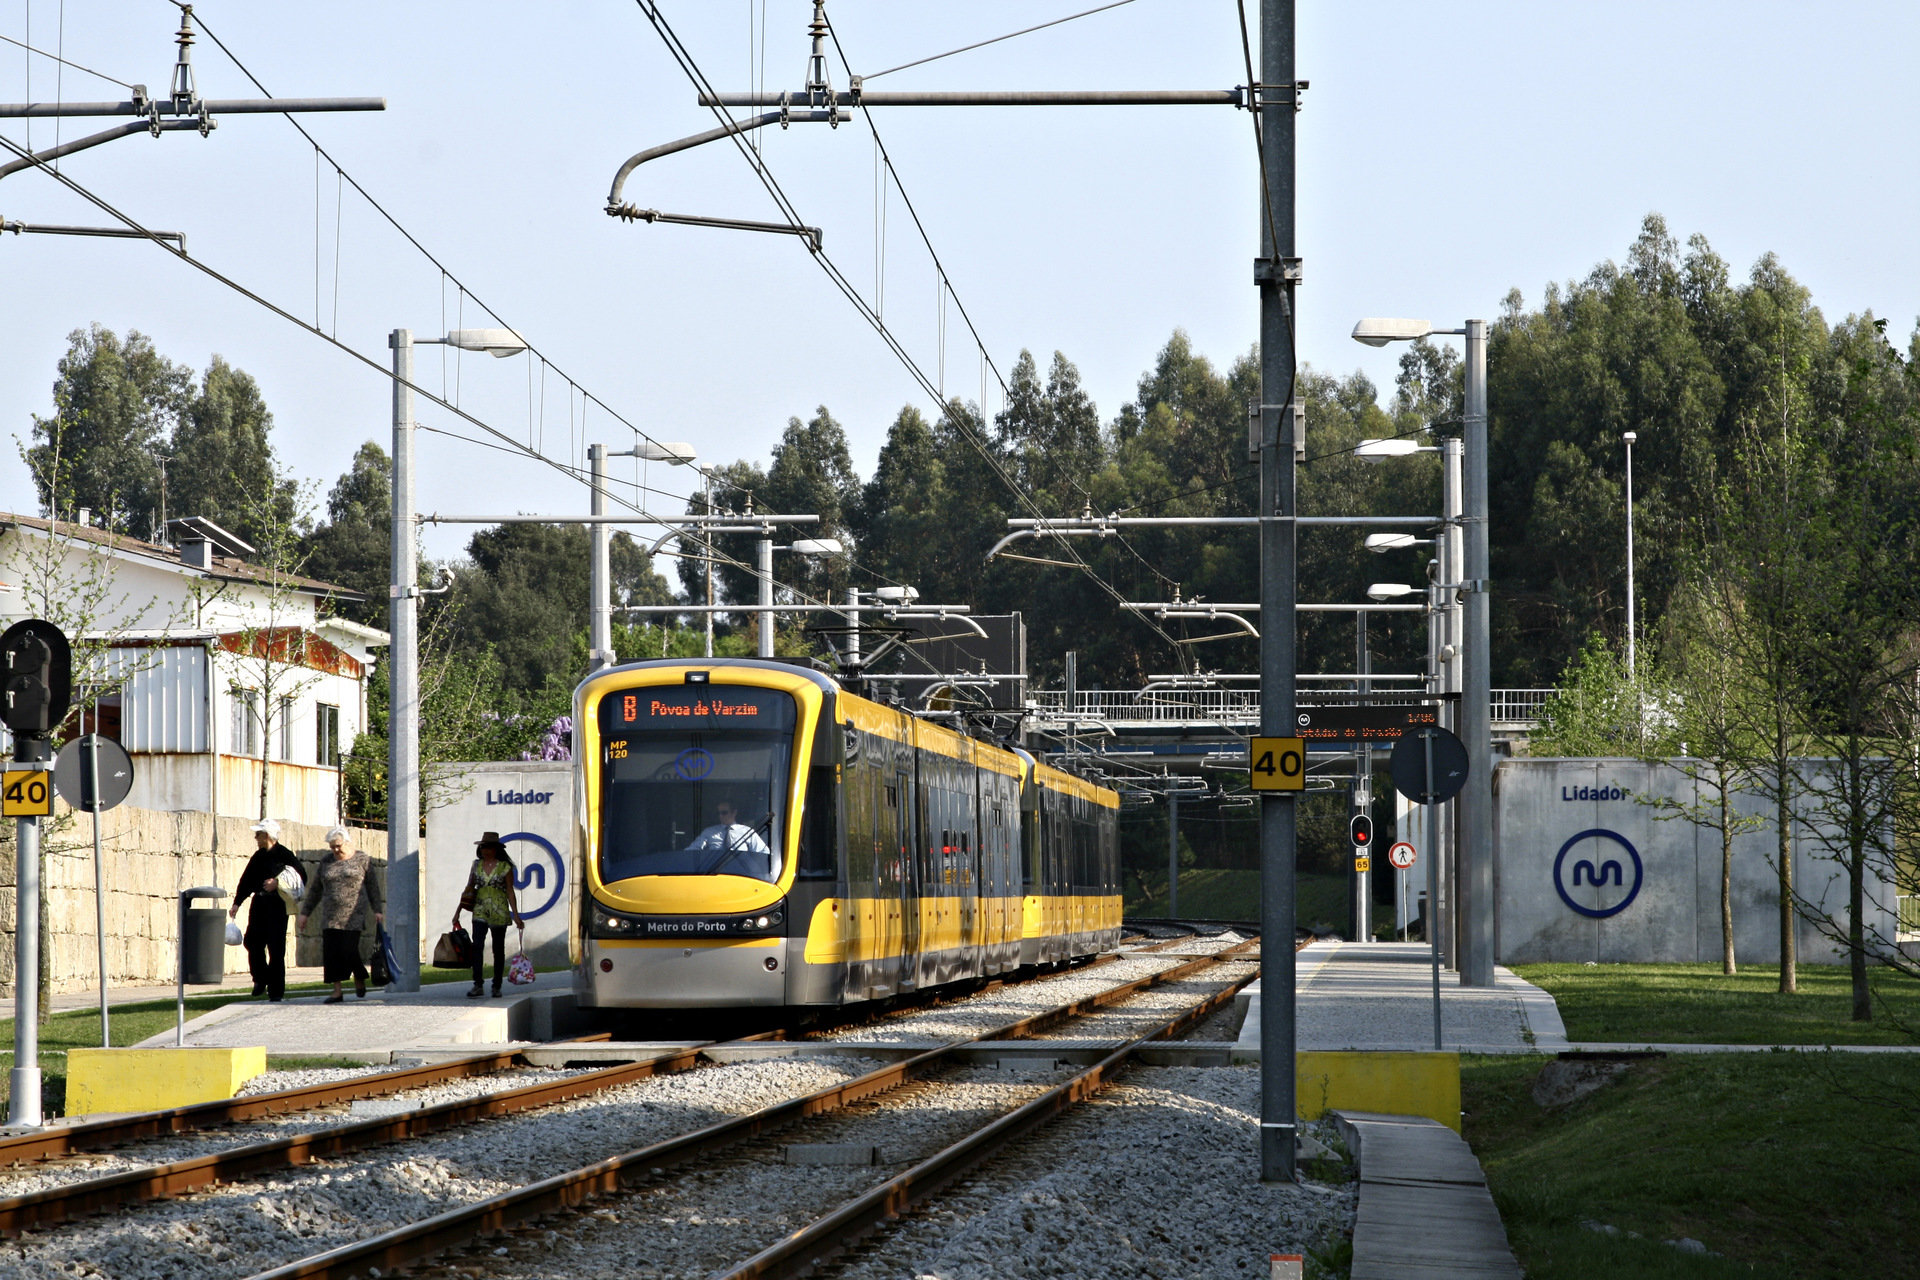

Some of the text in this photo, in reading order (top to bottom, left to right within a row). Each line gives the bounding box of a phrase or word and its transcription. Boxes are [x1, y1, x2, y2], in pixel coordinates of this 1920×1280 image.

[624, 695, 637, 722] B
[693, 701, 710, 716] de
[712, 701, 758, 716] Varzim
[610, 741, 627, 750] MP
[609, 750, 628, 759] 120
[1253, 750, 1302, 777] 40
[5, 781, 46, 804] 40
[486, 789, 554, 805] Lidador
[1562, 786, 1630, 801] Lidador
[1357, 861, 1368, 869] 65
[647, 921, 726, 932] Metro do Porto
